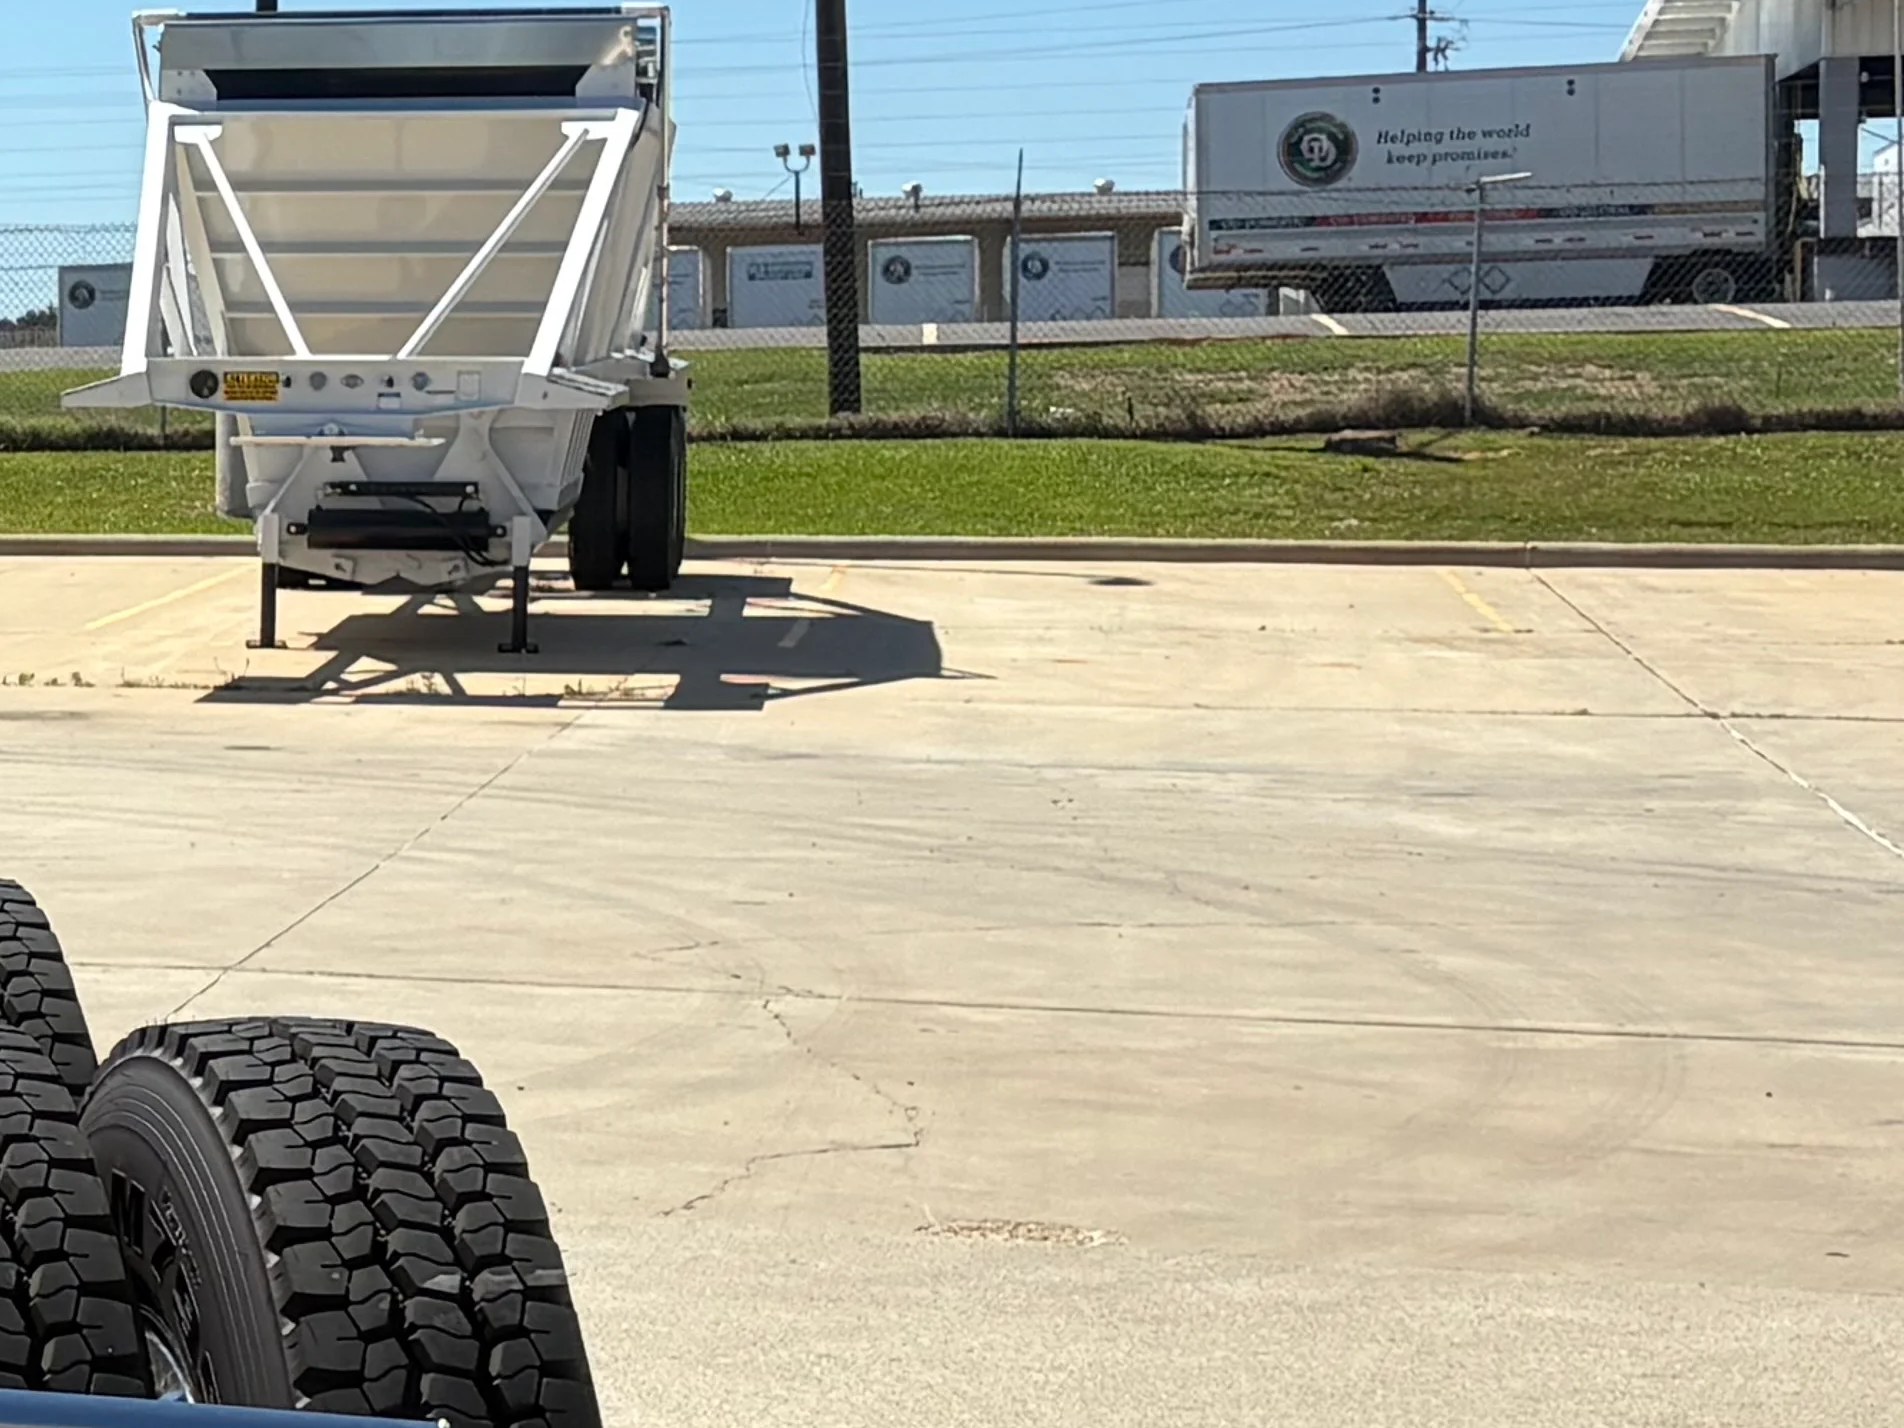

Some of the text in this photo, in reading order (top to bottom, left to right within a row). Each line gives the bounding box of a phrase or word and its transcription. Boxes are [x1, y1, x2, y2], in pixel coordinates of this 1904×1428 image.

[1376, 123, 1531, 147] Helping the world
[1386, 149, 1427, 167] keep
